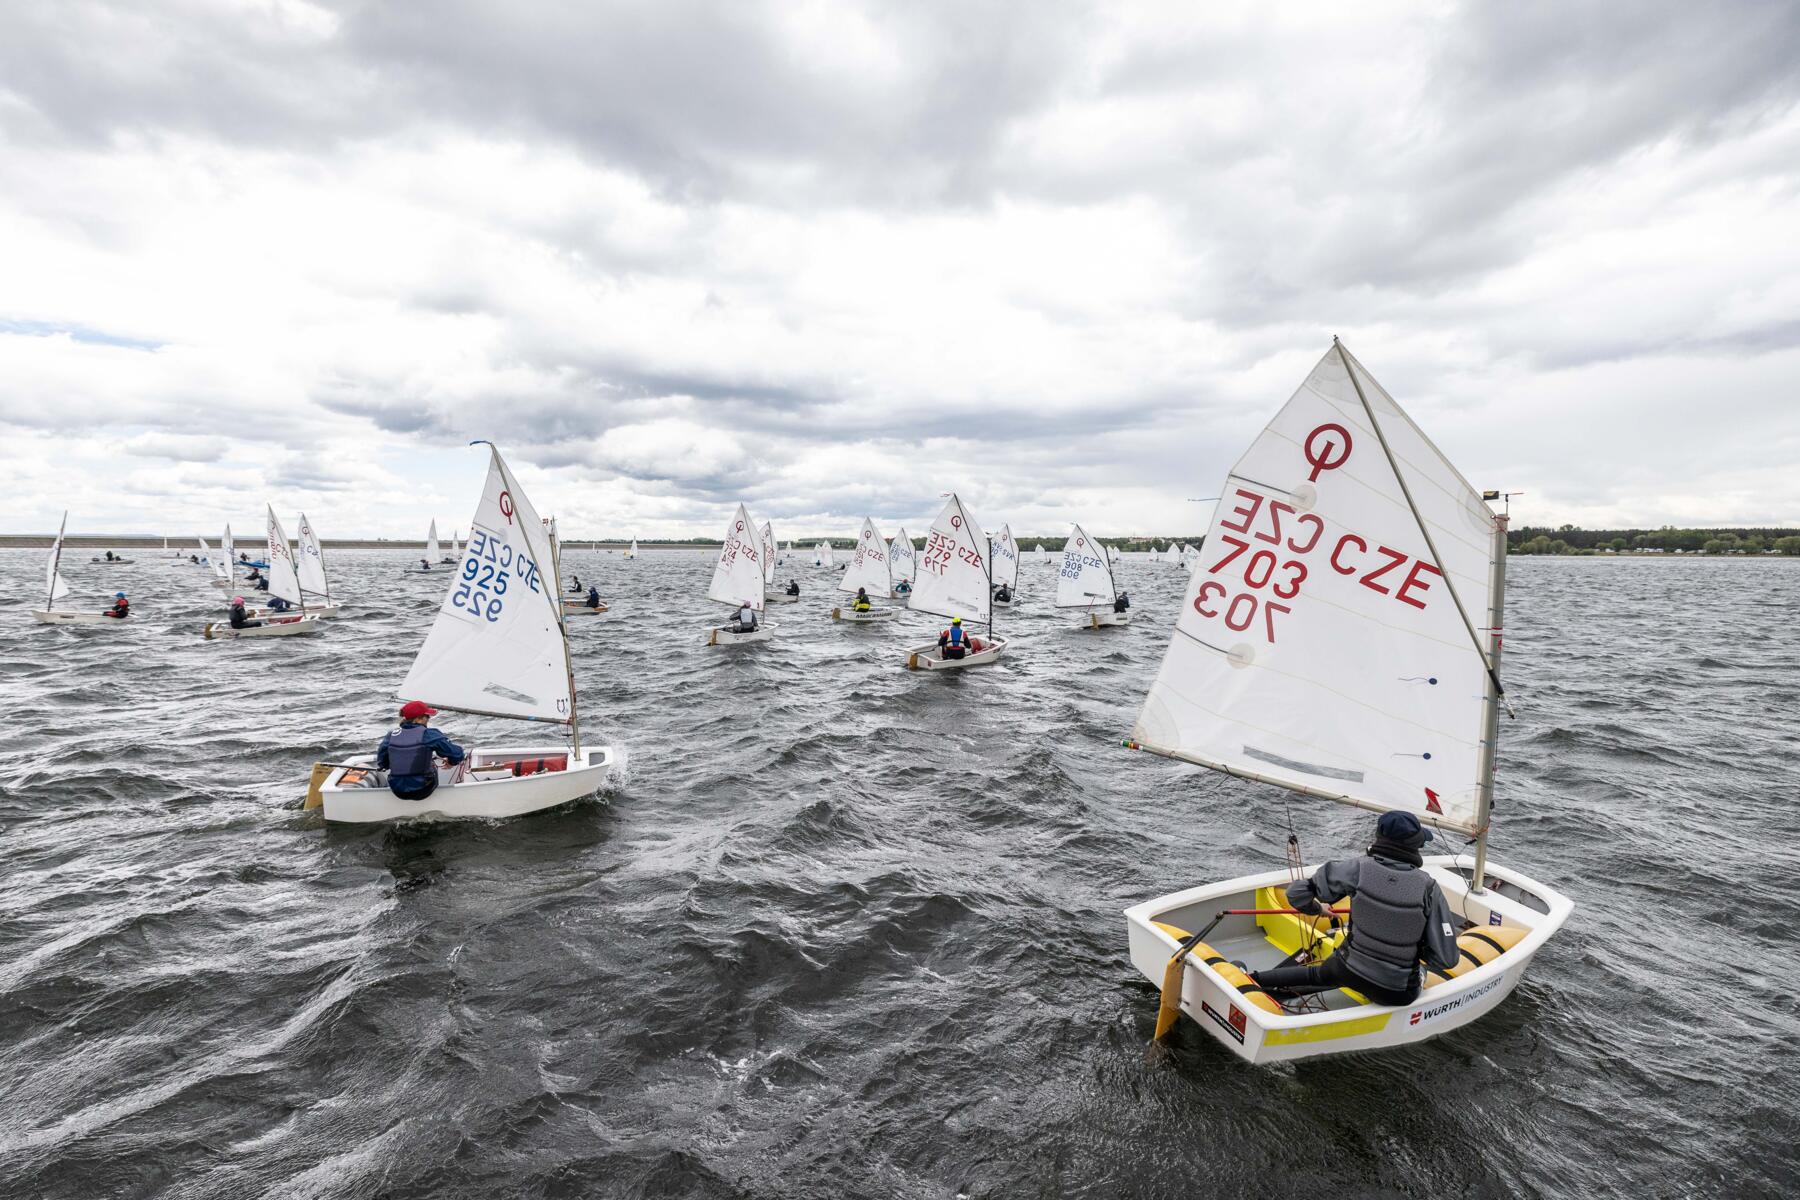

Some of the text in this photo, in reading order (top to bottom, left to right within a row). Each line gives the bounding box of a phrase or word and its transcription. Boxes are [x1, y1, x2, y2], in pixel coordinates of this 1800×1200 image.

[741, 544, 759, 562] CZE
[867, 548, 885, 562] CZE
[927, 543, 951, 563] 779
[958, 546, 983, 569] CZE
[1082, 556, 1101, 569] CZE
[462, 558, 510, 596] 925
[516, 553, 540, 594] CZE
[1065, 560, 1082, 572] 908
[1207, 534, 1308, 600] 703
[1330, 534, 1445, 610] CZE
[1464, 975, 1505, 1003] INDUSTRY
